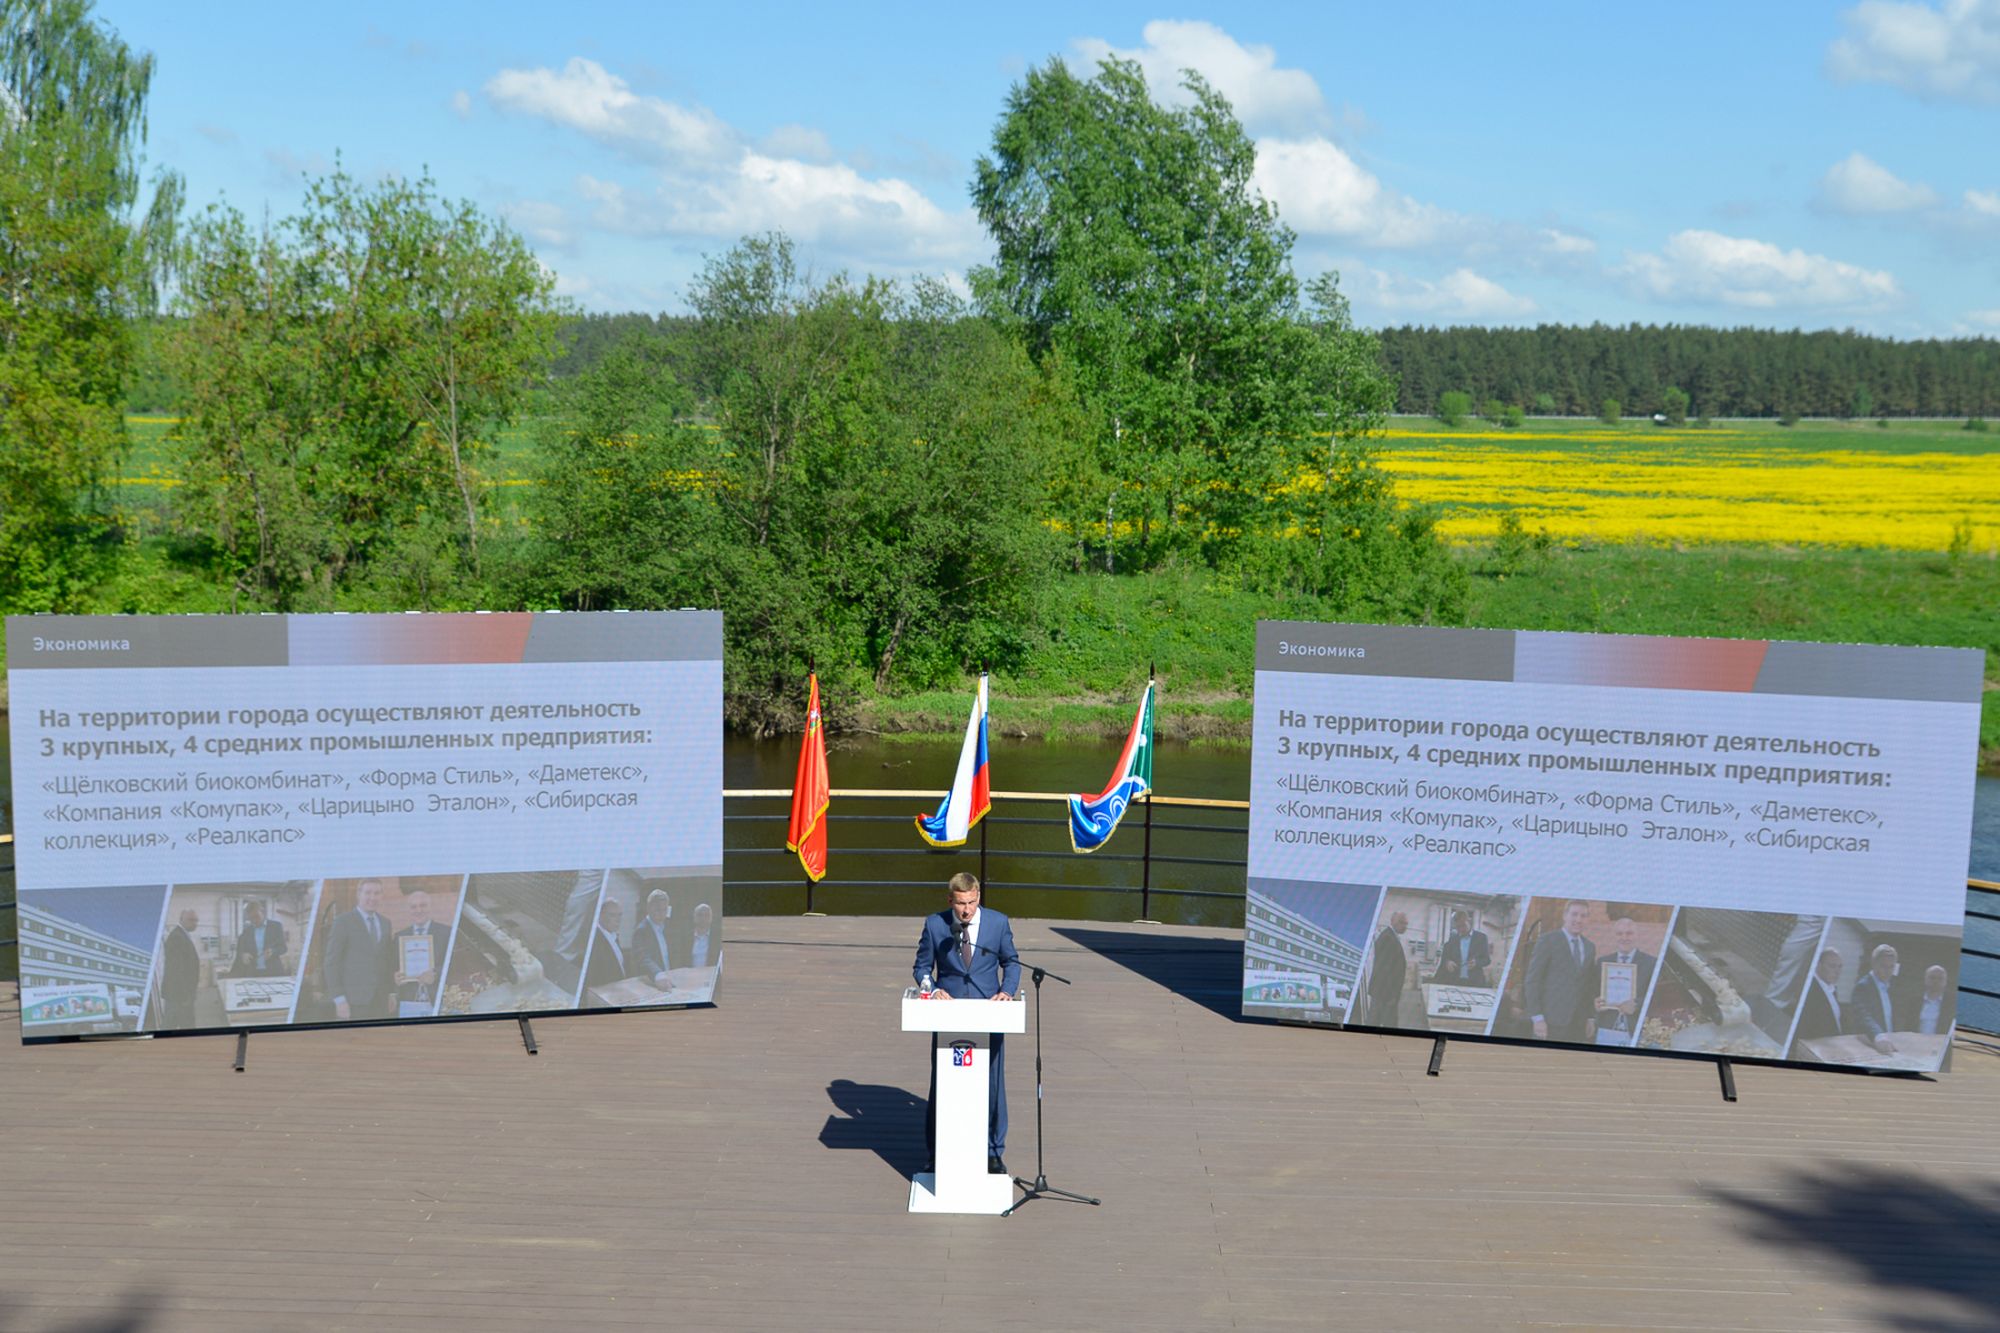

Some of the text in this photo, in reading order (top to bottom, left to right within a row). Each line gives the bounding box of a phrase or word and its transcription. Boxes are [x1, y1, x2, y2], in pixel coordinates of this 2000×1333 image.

[33, 637, 130, 651] Экономика
[1279, 641, 1366, 658] Экономика
[39, 702, 641, 731] На территории города осуществляют деятельность
[40, 728, 652, 760] 3 крупных, 4 средних промышленных предприятия:
[1279, 709, 1881, 758] На территории города осуществляют деятельность
[1278, 737, 1892, 788] 3 крупных, 4 средних промышленных предприятия:
[42, 763, 648, 797] «Щёлковский биокомбинат», «Форма Стиль», «Даметекс»,
[43, 790, 638, 823] «Компания «Комупак», «Царицыно Эталон», «Сибирская
[1276, 773, 1884, 828] «Щёлковский биокомбинат», «Форма Стиль», «Даметекс»,
[44, 826, 306, 851] коллекция», «Реалкапс»
[1276, 800, 1870, 852] «Компания «Комупак», «Царицыно Эталон», «Сибирская
[1274, 828, 1517, 857] коллекция», «Реалкапс»
